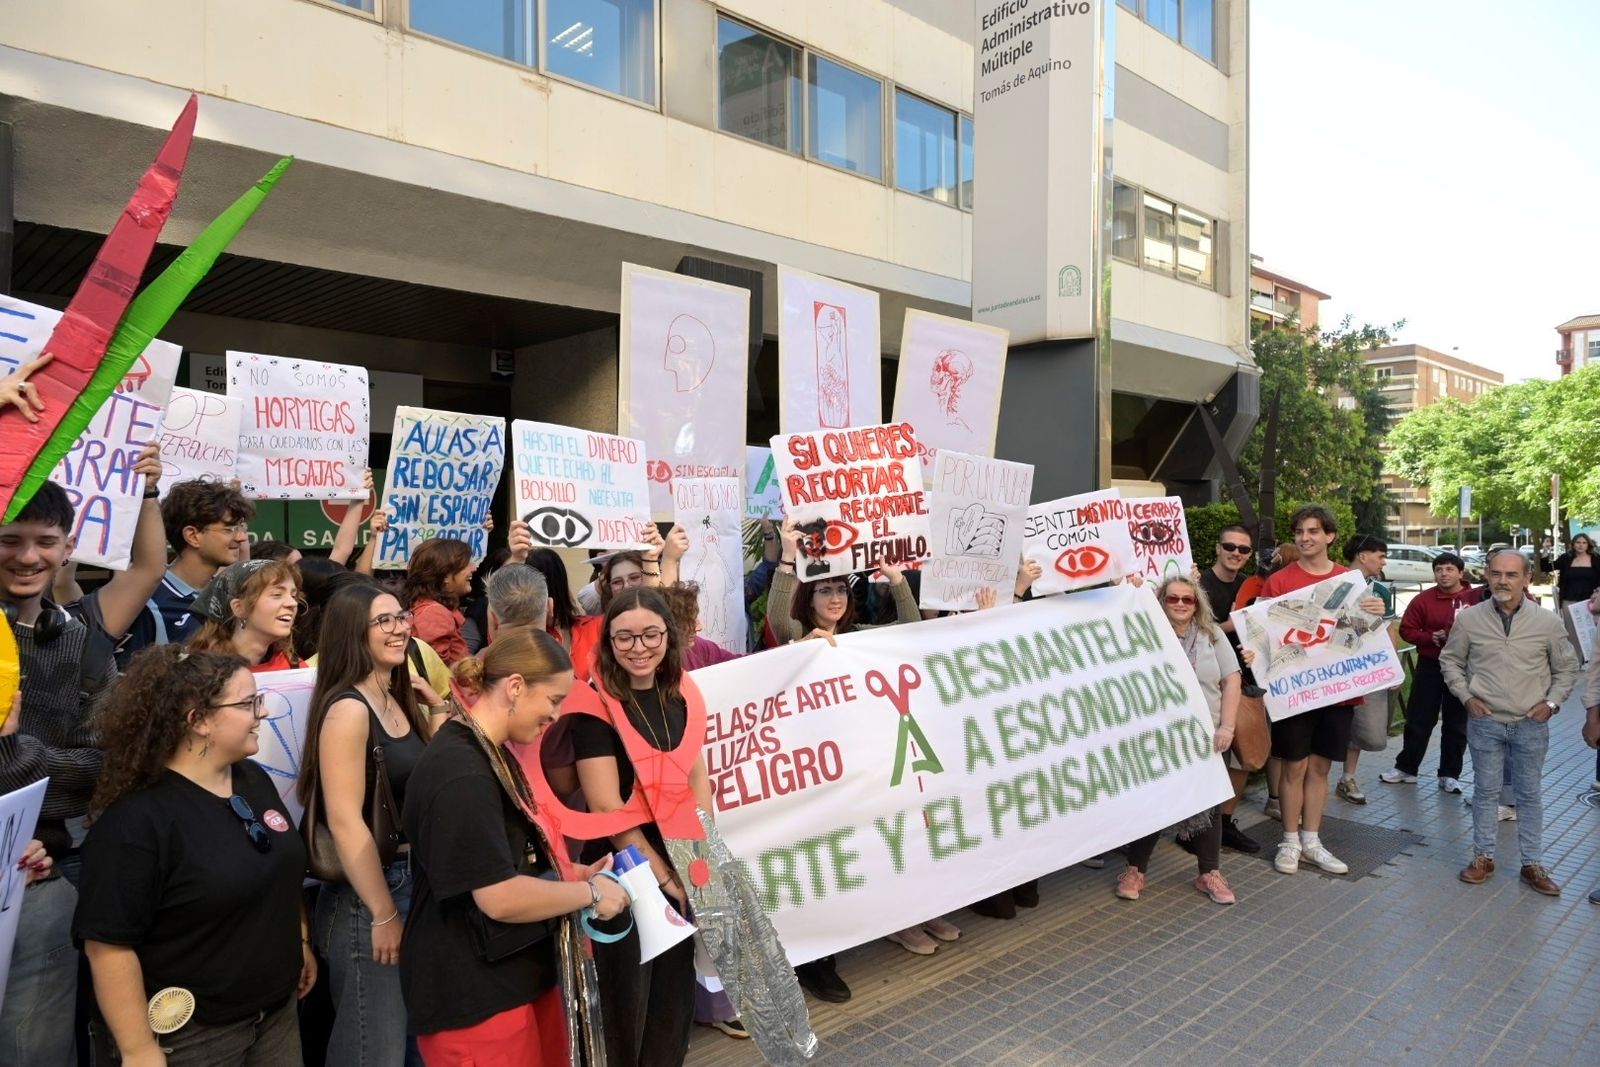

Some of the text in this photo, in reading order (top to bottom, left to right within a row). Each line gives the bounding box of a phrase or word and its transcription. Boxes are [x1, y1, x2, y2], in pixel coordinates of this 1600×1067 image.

[981, 0, 1090, 54] Administrativo
[983, 0, 1028, 31] Edificio
[981, 40, 1033, 77] Múltiple
[980, 58, 1072, 103] Tomás de Aquino
[205, 366, 226, 376] Edi
[250, 368, 346, 389] NO SOMOS
[160, 394, 226, 435] OP
[254, 396, 355, 434] HORMIGAS
[160, 432, 234, 466] FERENCIAS
[239, 435, 264, 449] PARA
[269, 435, 323, 451] QUEDARNOS
[326, 439, 343, 451] CON
[403, 420, 503, 457] AULAS A
[522, 429, 637, 464] HASTA EL DINERO
[788, 423, 918, 470] SI QUIERES
[265, 458, 346, 487] MIGAJAS
[518, 454, 545, 476] QUE
[547, 457, 560, 477] TE
[600, 463, 615, 485] AL
[785, 461, 908, 506] RECORTAR
[942, 456, 975, 498] POR
[428, 494, 490, 527] ESPACIO
[521, 479, 634, 508] BOLSILLO NECESITA
[677, 483, 700, 510] QUE
[703, 483, 720, 510] NO
[872, 519, 896, 539] EL
[1047, 526, 1099, 550] COMÚN
[851, 535, 931, 570] FLEQUILLO.
[923, 609, 1163, 707] DESMANTELAN
[1269, 680, 1289, 697] NO
[1291, 668, 1316, 690] NOS
[1317, 650, 1388, 681] ENCONTRAMOS
[1288, 688, 1319, 709] ENTRE
[1352, 667, 1396, 687] RECORTES
[704, 674, 857, 745] ELAS DE ARTE
[962, 662, 1188, 774] A ESCONDIDAS
[704, 726, 781, 776] LUZAS
[873, 810, 907, 875] Y
[922, 795, 983, 863] EL
[985, 714, 1211, 840] PENSAMIENTO
